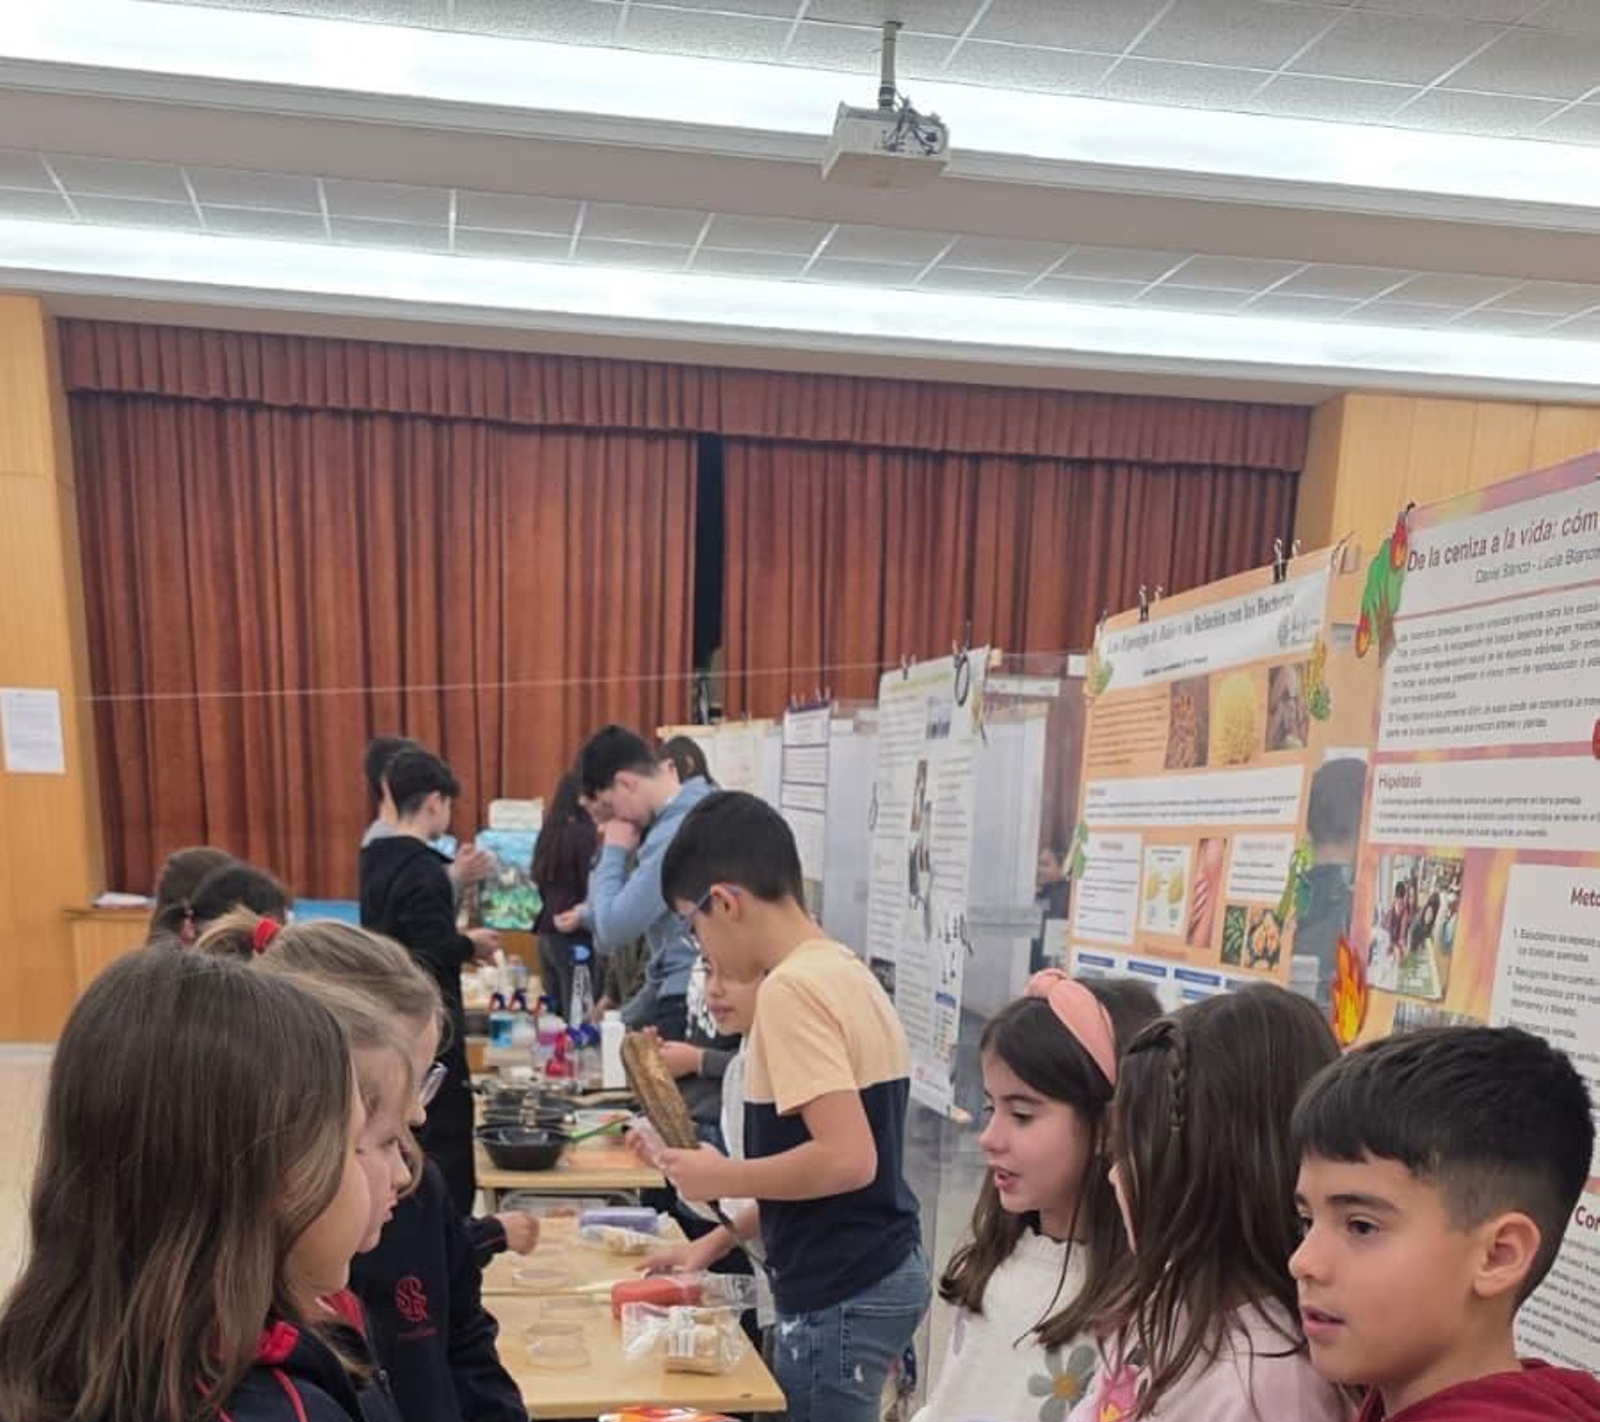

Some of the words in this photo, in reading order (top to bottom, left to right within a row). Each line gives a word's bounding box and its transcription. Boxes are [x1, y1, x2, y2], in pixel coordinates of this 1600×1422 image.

[1407, 550, 1425, 571] De
[1429, 545, 1440, 566] la
[1444, 535, 1487, 565] ceniza
[1491, 536, 1499, 553] a
[1503, 526, 1516, 550] la
[1520, 518, 1558, 545] vida:
[1378, 773, 1422, 790] Hipótesis
